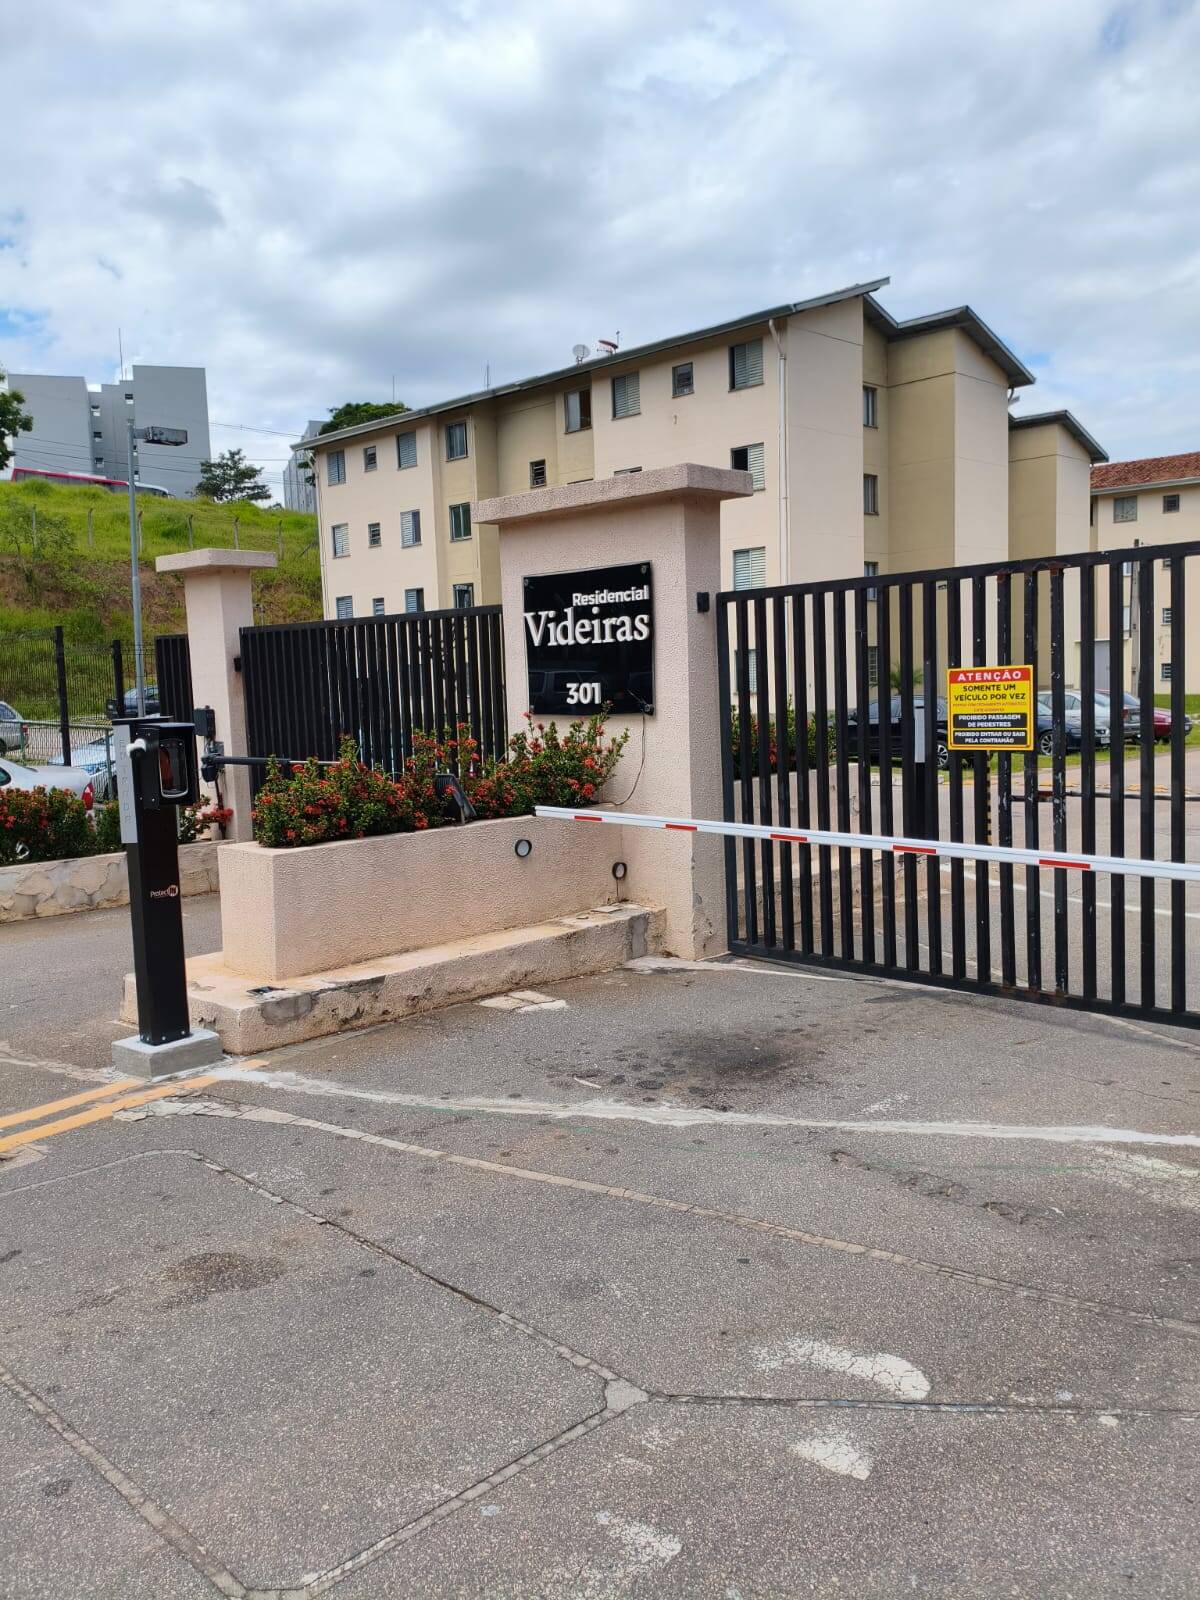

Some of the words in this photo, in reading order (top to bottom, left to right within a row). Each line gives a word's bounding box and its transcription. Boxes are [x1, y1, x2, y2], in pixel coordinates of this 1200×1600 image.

[572, 585, 650, 607] Residencial
[523, 606, 650, 647] Videiras
[957, 670, 1022, 682] ATENÇÃO
[566, 682, 602, 704] 301
[963, 684, 1001, 692] SOMENTE
[1003, 683, 1016, 691] UM
[954, 693, 988, 702] VEÍCULO
[990, 693, 1007, 701] POR
[1009, 692, 1026, 700] VEZ
